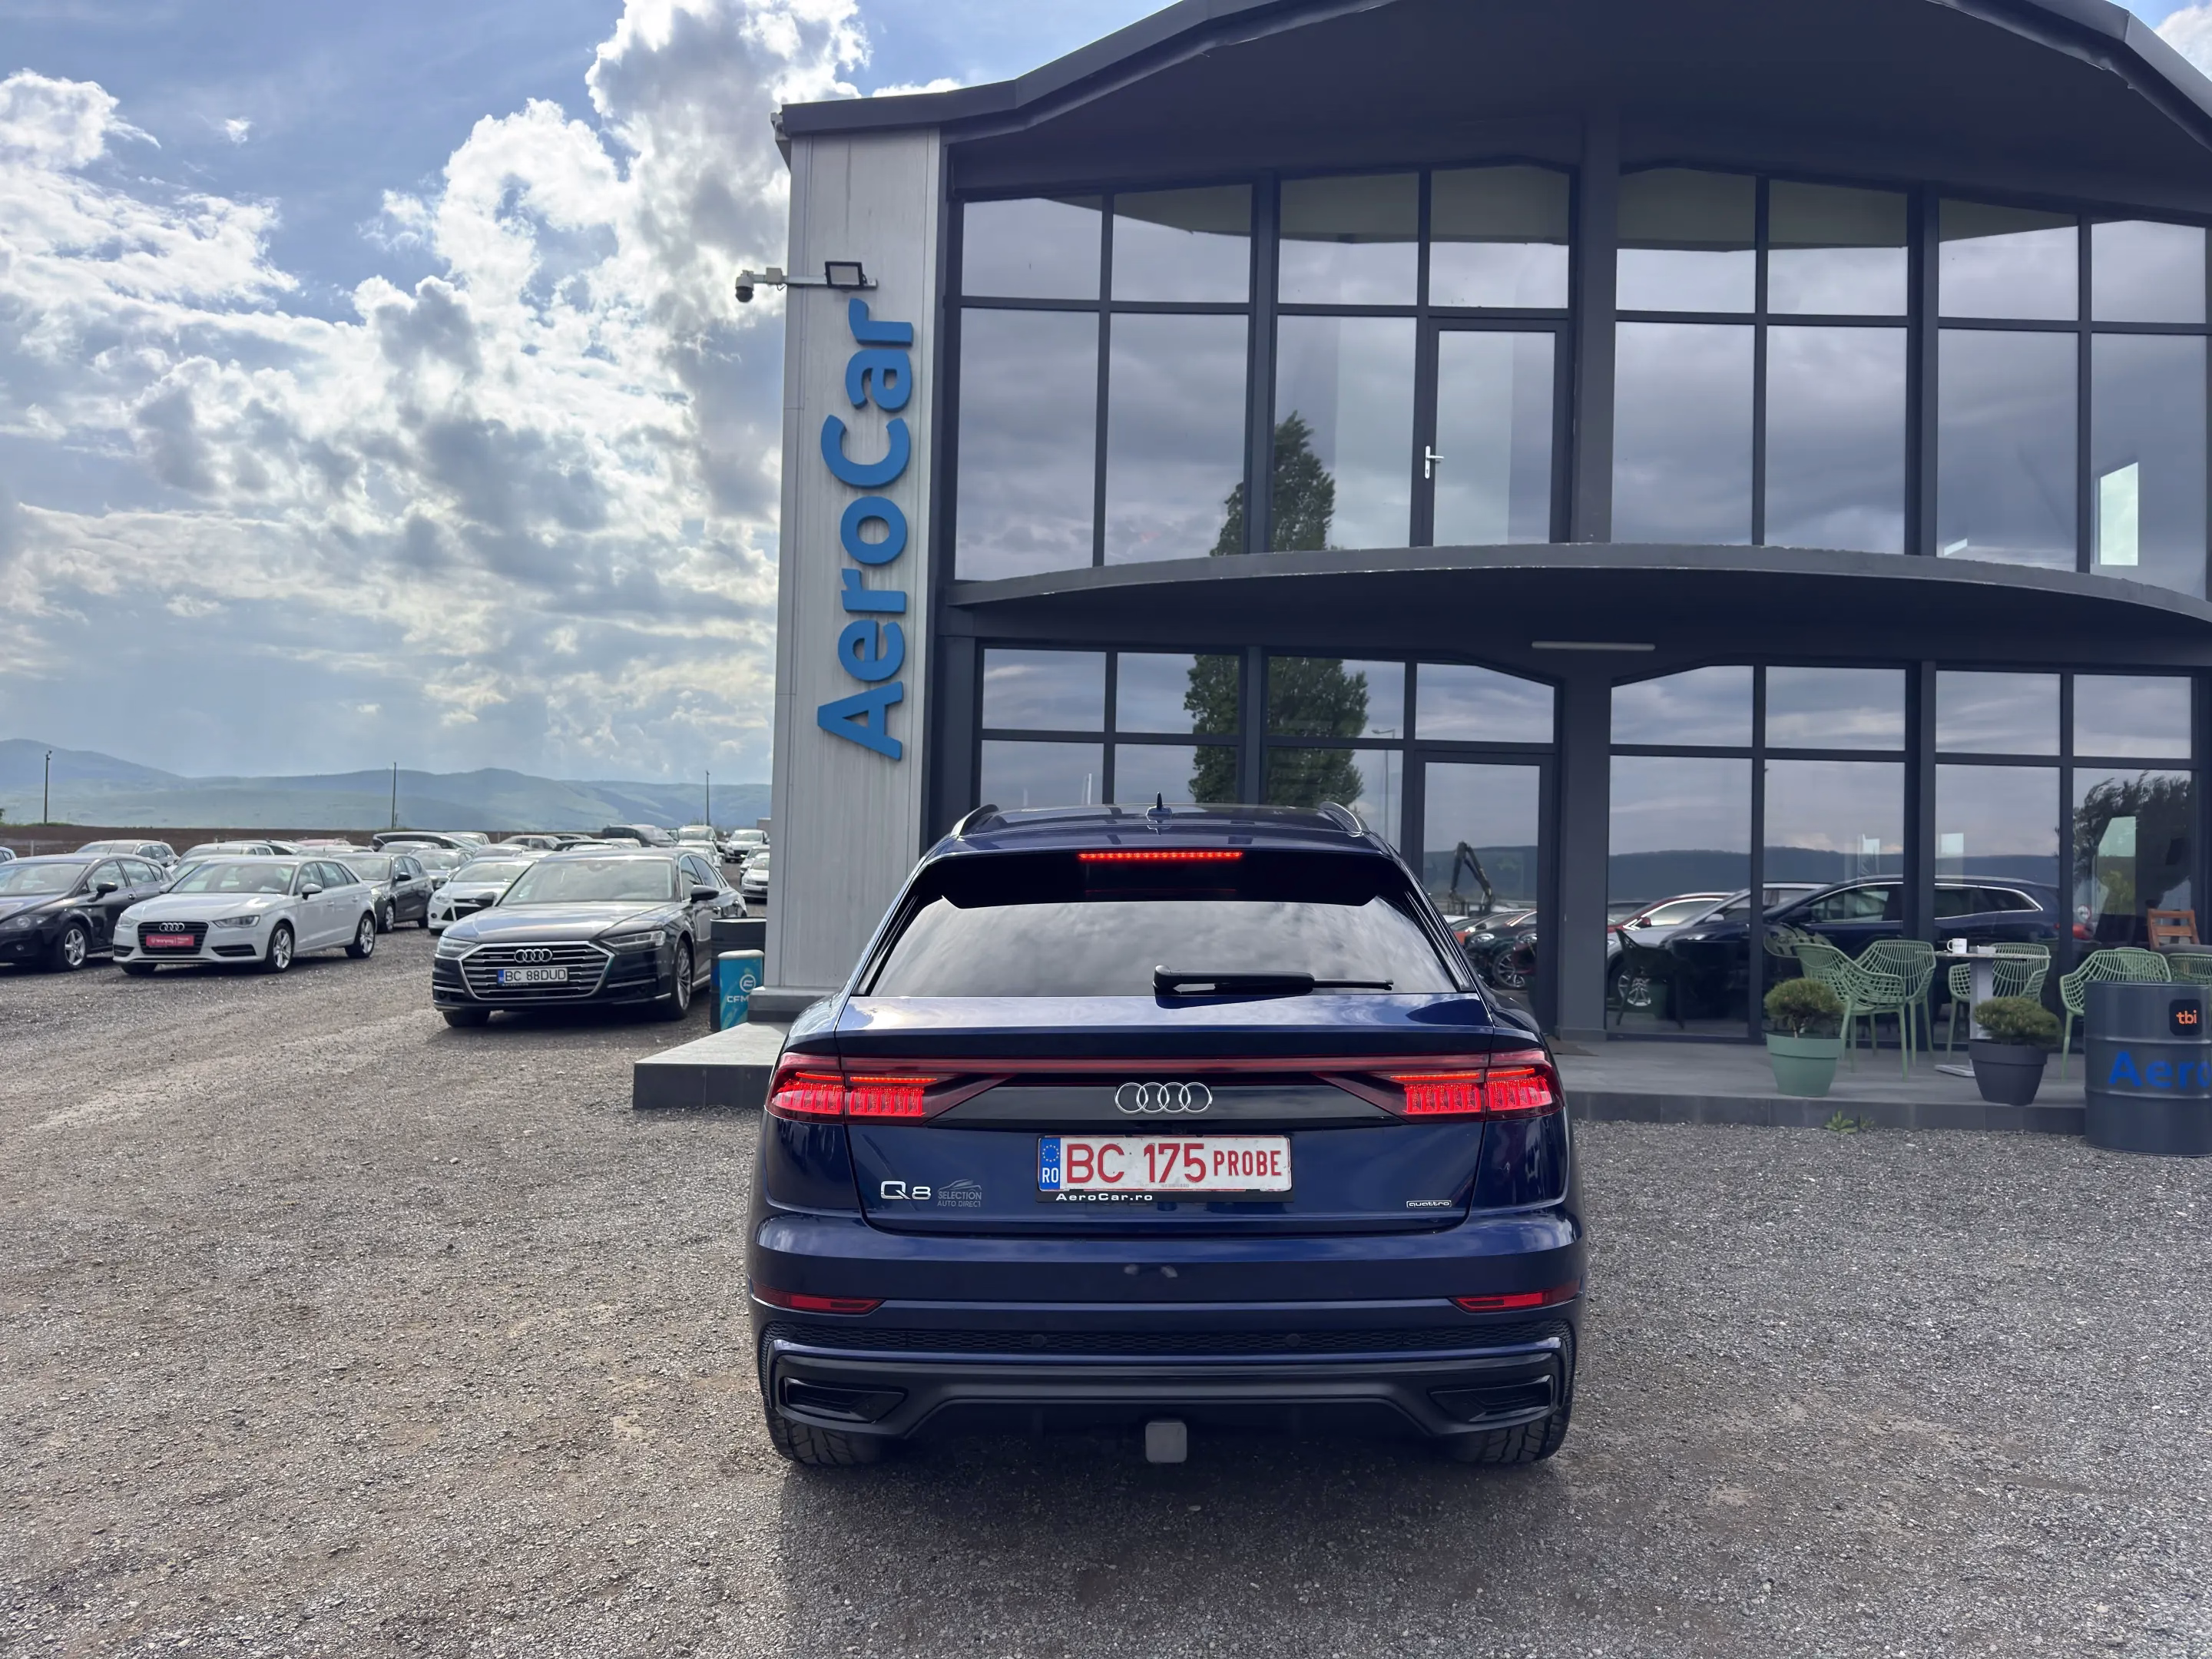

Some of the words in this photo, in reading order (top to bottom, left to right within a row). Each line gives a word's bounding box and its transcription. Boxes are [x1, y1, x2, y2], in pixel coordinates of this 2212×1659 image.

[817, 297, 914, 761] AeroCar
[505, 970, 522, 982] BC
[526, 969, 566, 981] 88DUD
[2175, 1009, 2197, 1025] tbi
[1066, 1143, 1125, 1184] BC
[1143, 1143, 1207, 1184] 175
[1213, 1150, 1282, 1177] PROBE
[1041, 1167, 1059, 1184] RO
[880, 1181, 932, 1200] Q8
[938, 1190, 982, 1200] SELECTION
[1055, 1193, 1153, 1202] AeroCar.ro
[958, 1200, 982, 1208] DIRECT
